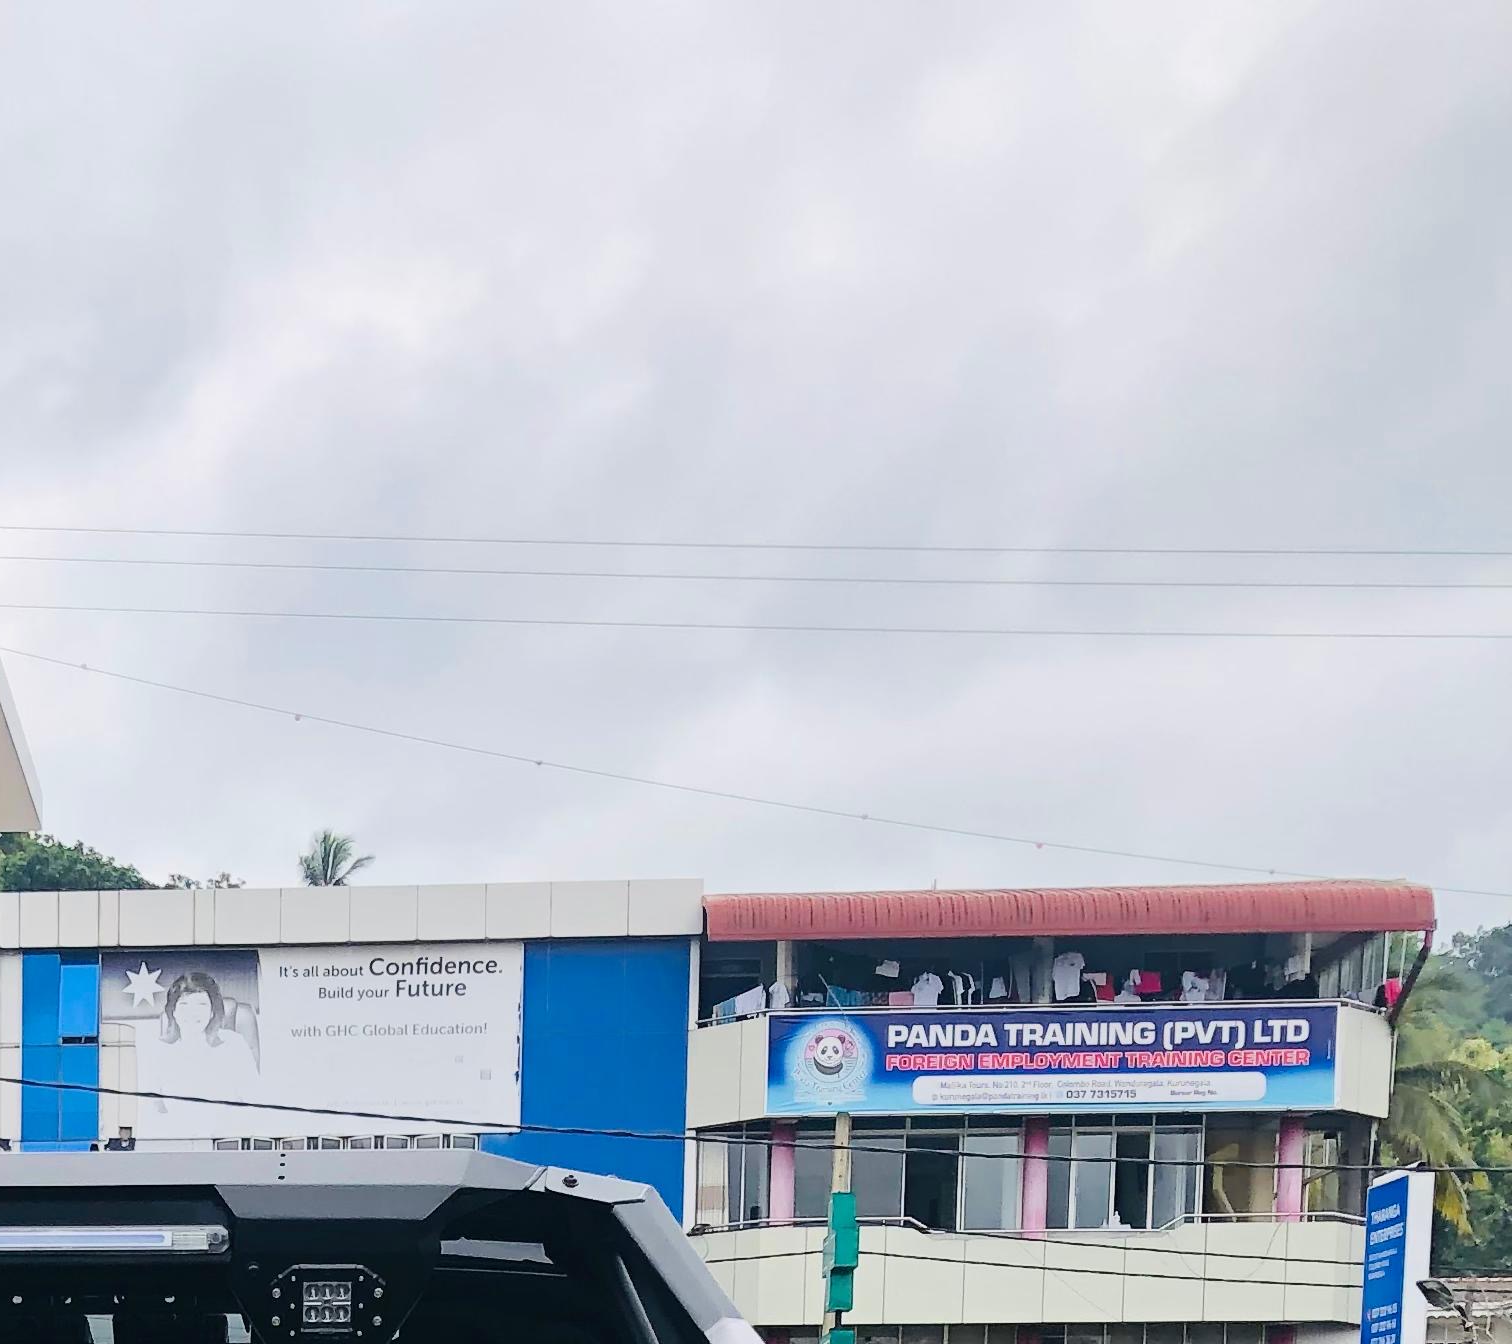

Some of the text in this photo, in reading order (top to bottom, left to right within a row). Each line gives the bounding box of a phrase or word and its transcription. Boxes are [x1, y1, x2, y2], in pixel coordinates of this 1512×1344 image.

[279, 957, 503, 978] It's all about Confidence.
[318, 979, 468, 1001] Build your Future
[291, 1022, 488, 1038] with GHC Global Education!
[887, 1023, 999, 1049] PANDA
[1003, 1020, 1157, 1048] TRAINING
[1163, 1019, 1246, 1050] (PVT)
[1253, 1018, 1311, 1044] LTD
[885, 1053, 975, 1071] FOREIGN
[977, 1051, 1125, 1070] EMPLOYMENT
[1125, 1050, 1226, 1069] TRAINING
[1227, 1048, 1311, 1067] CENTER
[1066, 1090, 1087, 1099] 037
[1089, 1089, 1138, 1099] 7315715
